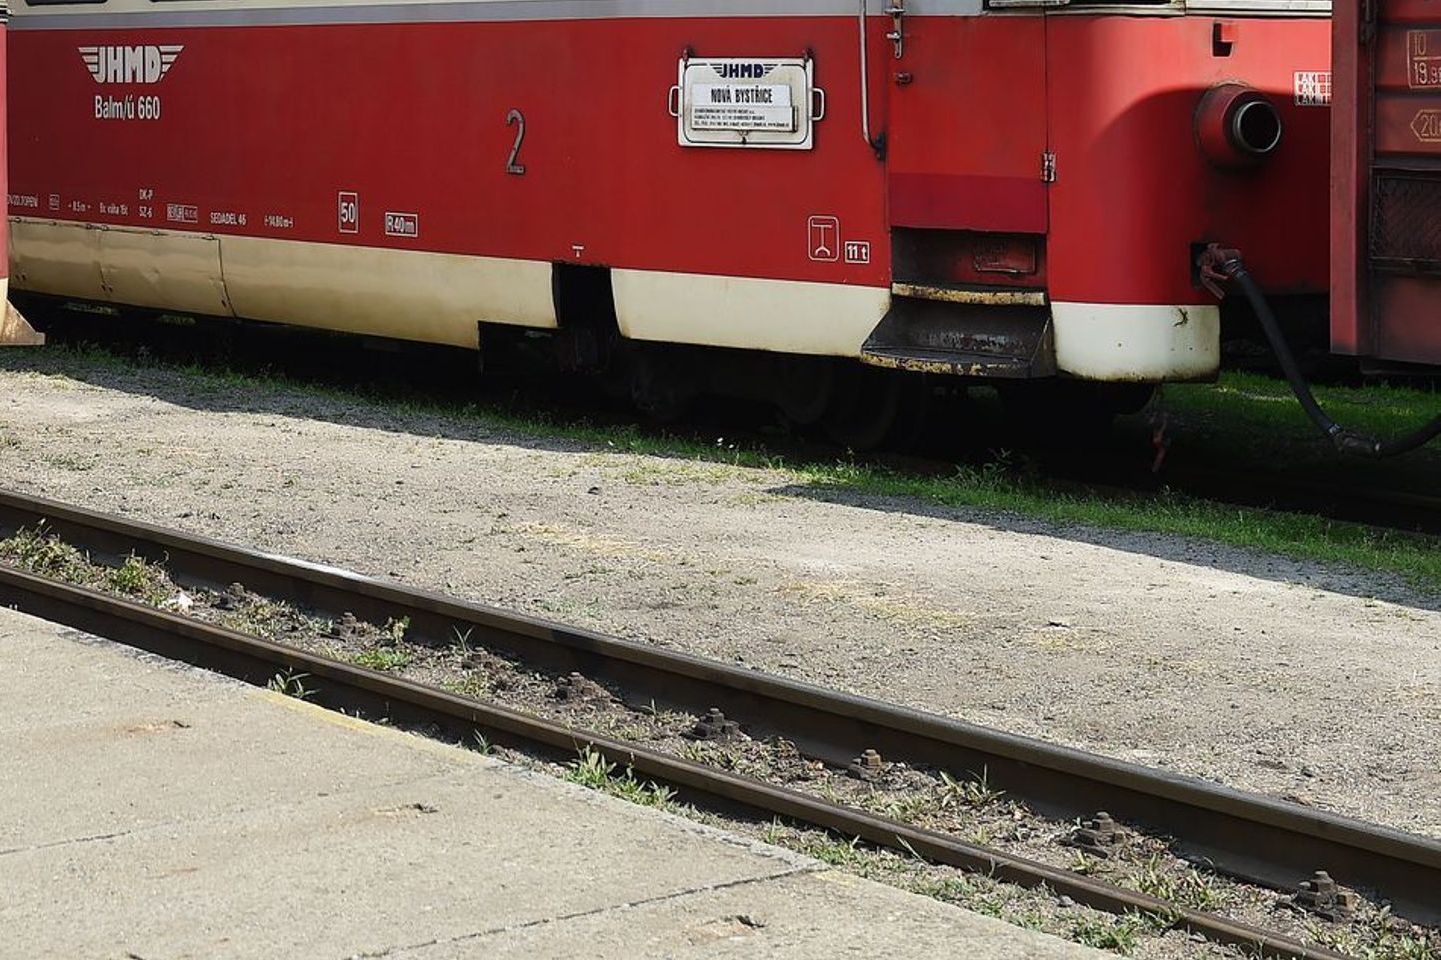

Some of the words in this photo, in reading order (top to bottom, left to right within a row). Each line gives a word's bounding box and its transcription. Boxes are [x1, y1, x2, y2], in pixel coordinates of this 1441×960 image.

[92, 46, 162, 83] JHMD
[719, 63, 764, 78] JHMD
[711, 85, 732, 103] NOVÁ
[735, 85, 773, 103] BYSTŘICE
[138, 96, 160, 120] 660
[507, 108, 525, 175] 2
[210, 211, 237, 225] SEDADEL
[340, 202, 356, 223] 50
[848, 244, 858, 259] 11
[861, 246, 867, 260] t
